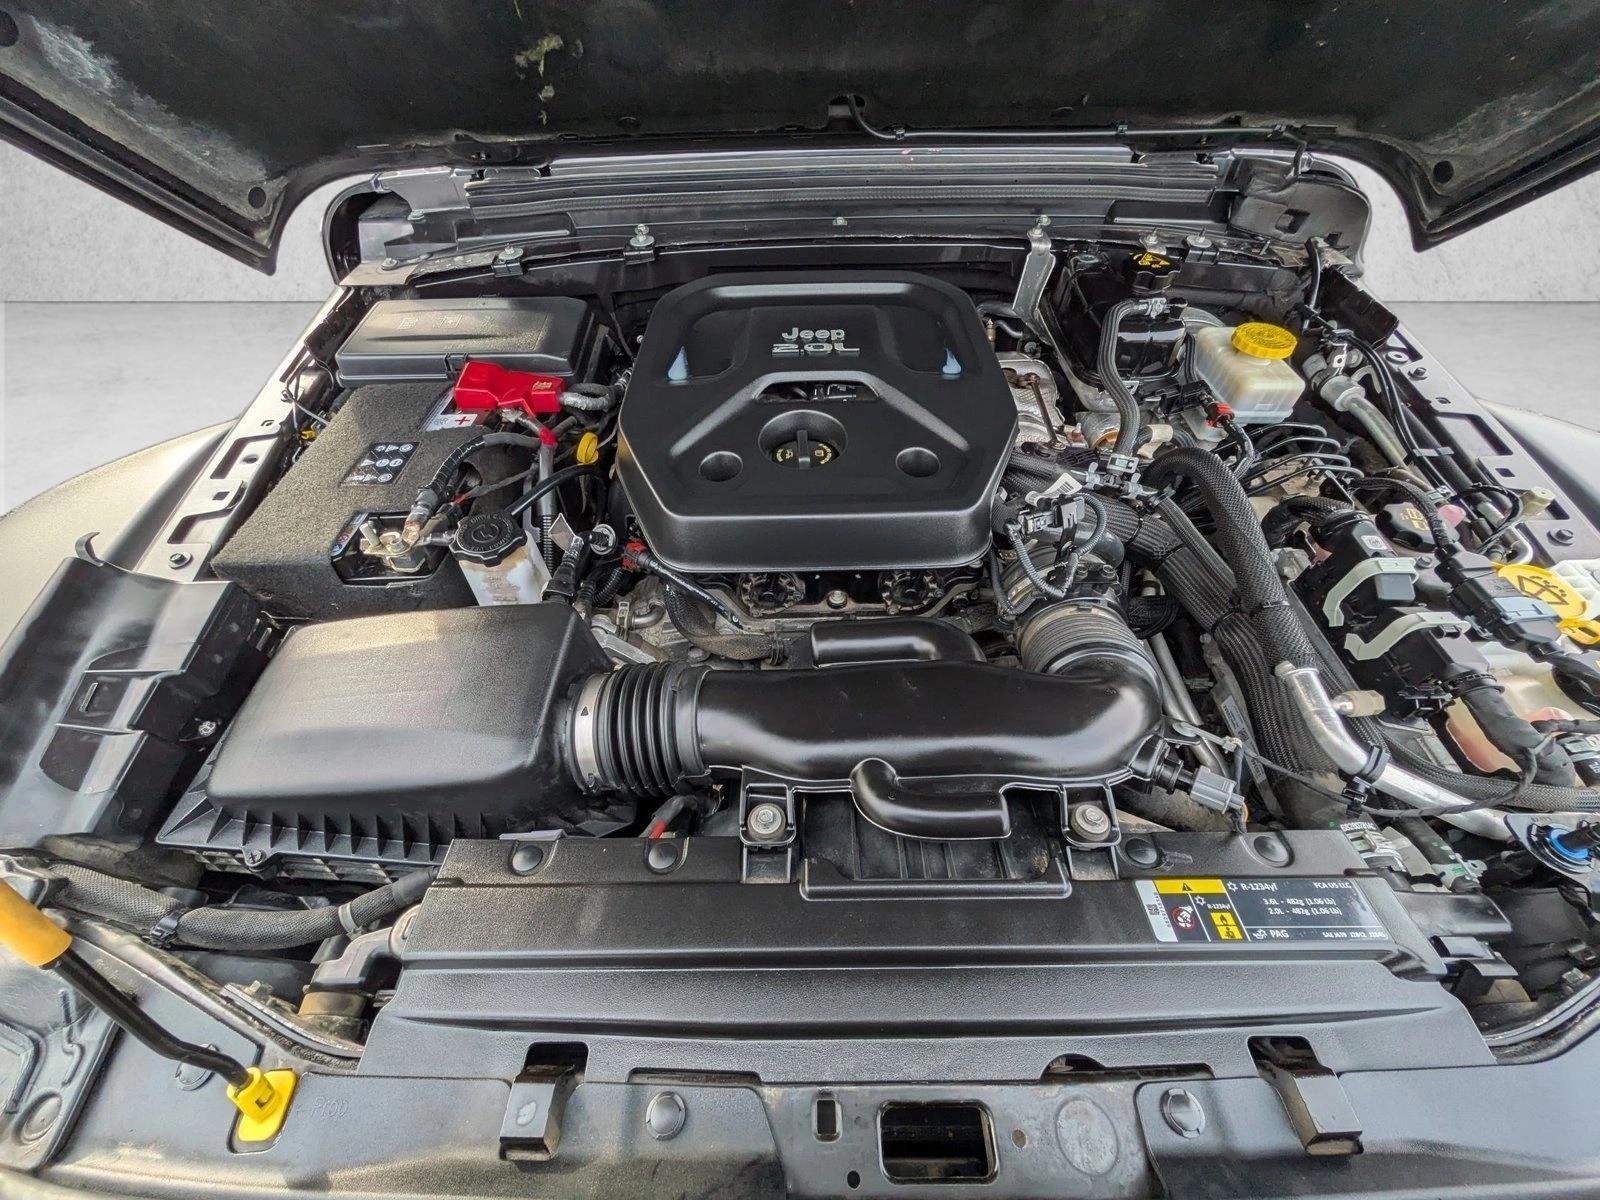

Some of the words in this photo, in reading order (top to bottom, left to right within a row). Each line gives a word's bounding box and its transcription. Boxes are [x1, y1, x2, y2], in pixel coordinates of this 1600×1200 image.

[781, 327, 845, 341] Jeep
[771, 342, 860, 357] 2.0L
[1240, 882, 1278, 892] R-1234yf
[1312, 881, 1328, 889] FCA
[1328, 881, 1339, 889] US
[1338, 880, 1352, 889] LLC
[1268, 907, 1285, 915] 2.0L
[1269, 929, 1289, 938] PAG
